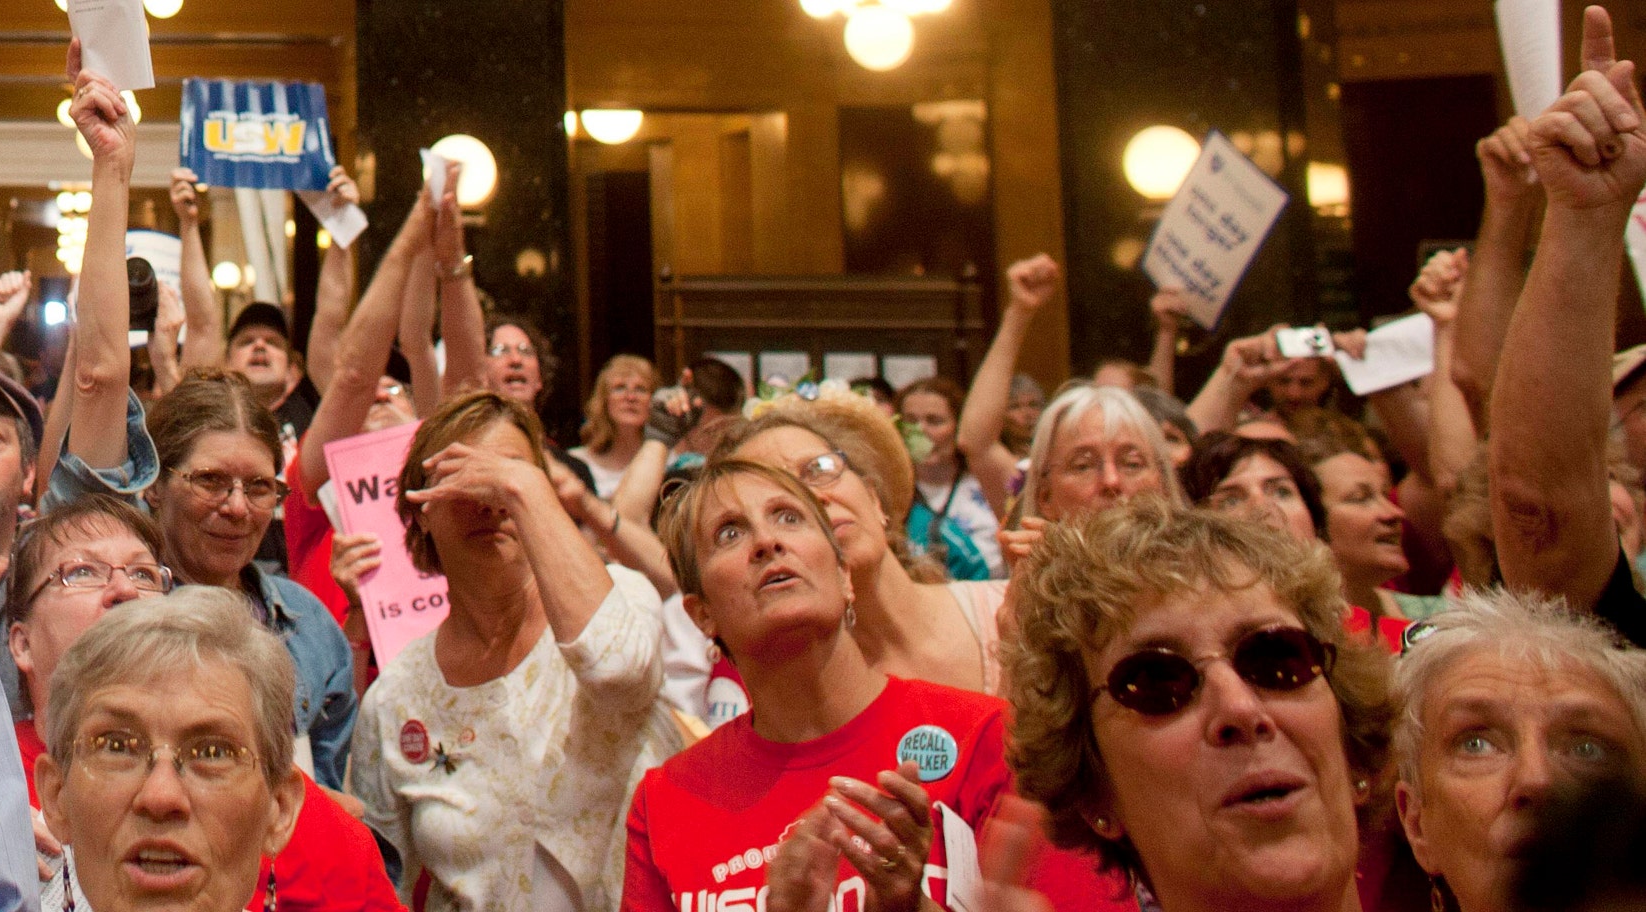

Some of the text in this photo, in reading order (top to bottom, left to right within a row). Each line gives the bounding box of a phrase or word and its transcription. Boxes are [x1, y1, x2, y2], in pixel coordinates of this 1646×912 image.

[204, 118, 306, 156] USW
[346, 474, 400, 505] Wa
[378, 593, 444, 620] is co
[903, 731, 948, 753] RECALL
